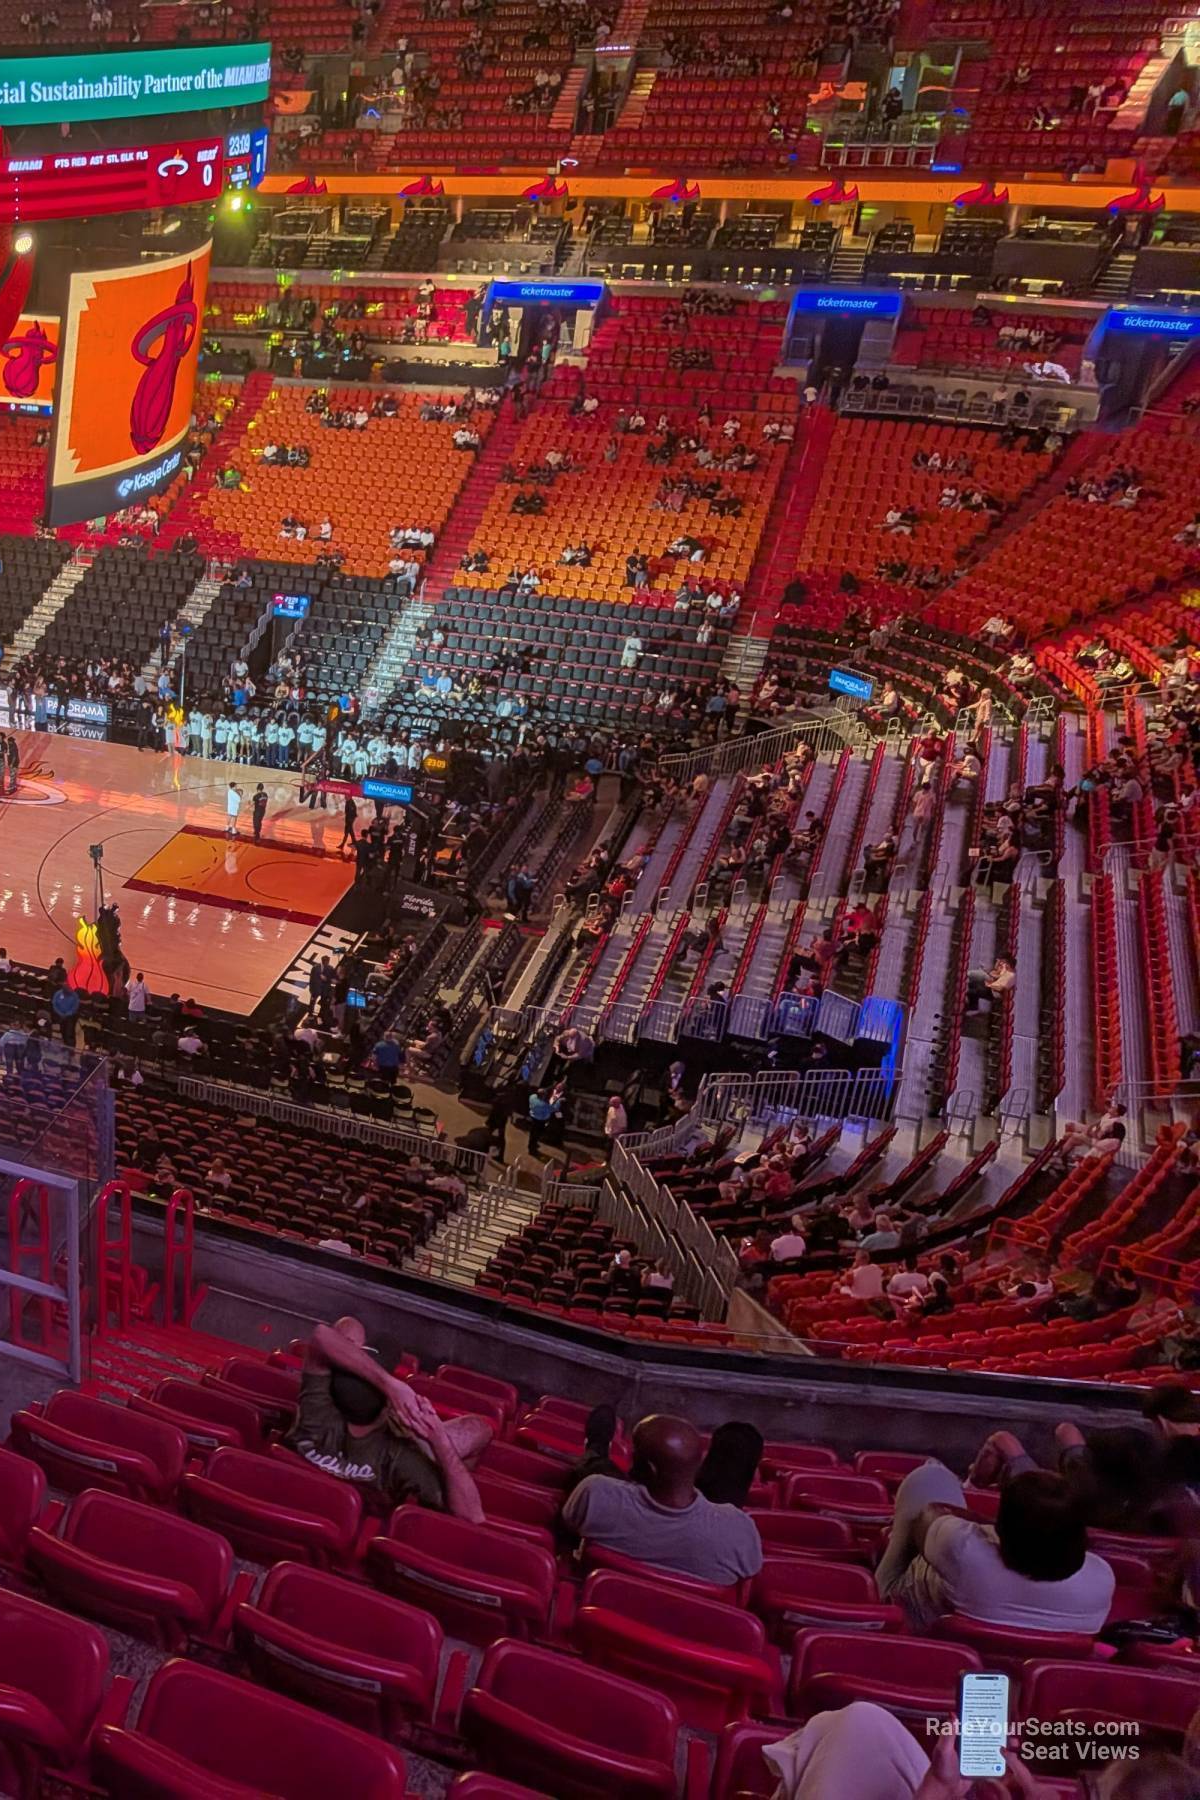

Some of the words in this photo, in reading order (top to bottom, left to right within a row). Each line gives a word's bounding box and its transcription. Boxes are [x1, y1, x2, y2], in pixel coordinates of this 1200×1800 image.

[31, 74, 141, 103] Sustainability
[144, 73, 192, 94] Partner
[194, 69, 207, 90] of
[207, 68, 222, 88] the
[224, 66, 255, 87] MIAMI
[228, 133, 251, 157] 23:09
[8, 160, 43, 172] MIAMI
[54, 158, 70, 168] PTS
[71, 157, 86, 167] REB
[90, 156, 104, 165] AST
[106, 155, 119, 164] STL
[136, 151, 148, 160] FLS
[203, 164, 212, 186] 0
[521, 286, 574, 297] ticketmaster
[817, 297, 878, 309] ticketmaster
[1123, 316, 1193, 330] ticketmaster
[134, 467, 162, 491] Kaseya
